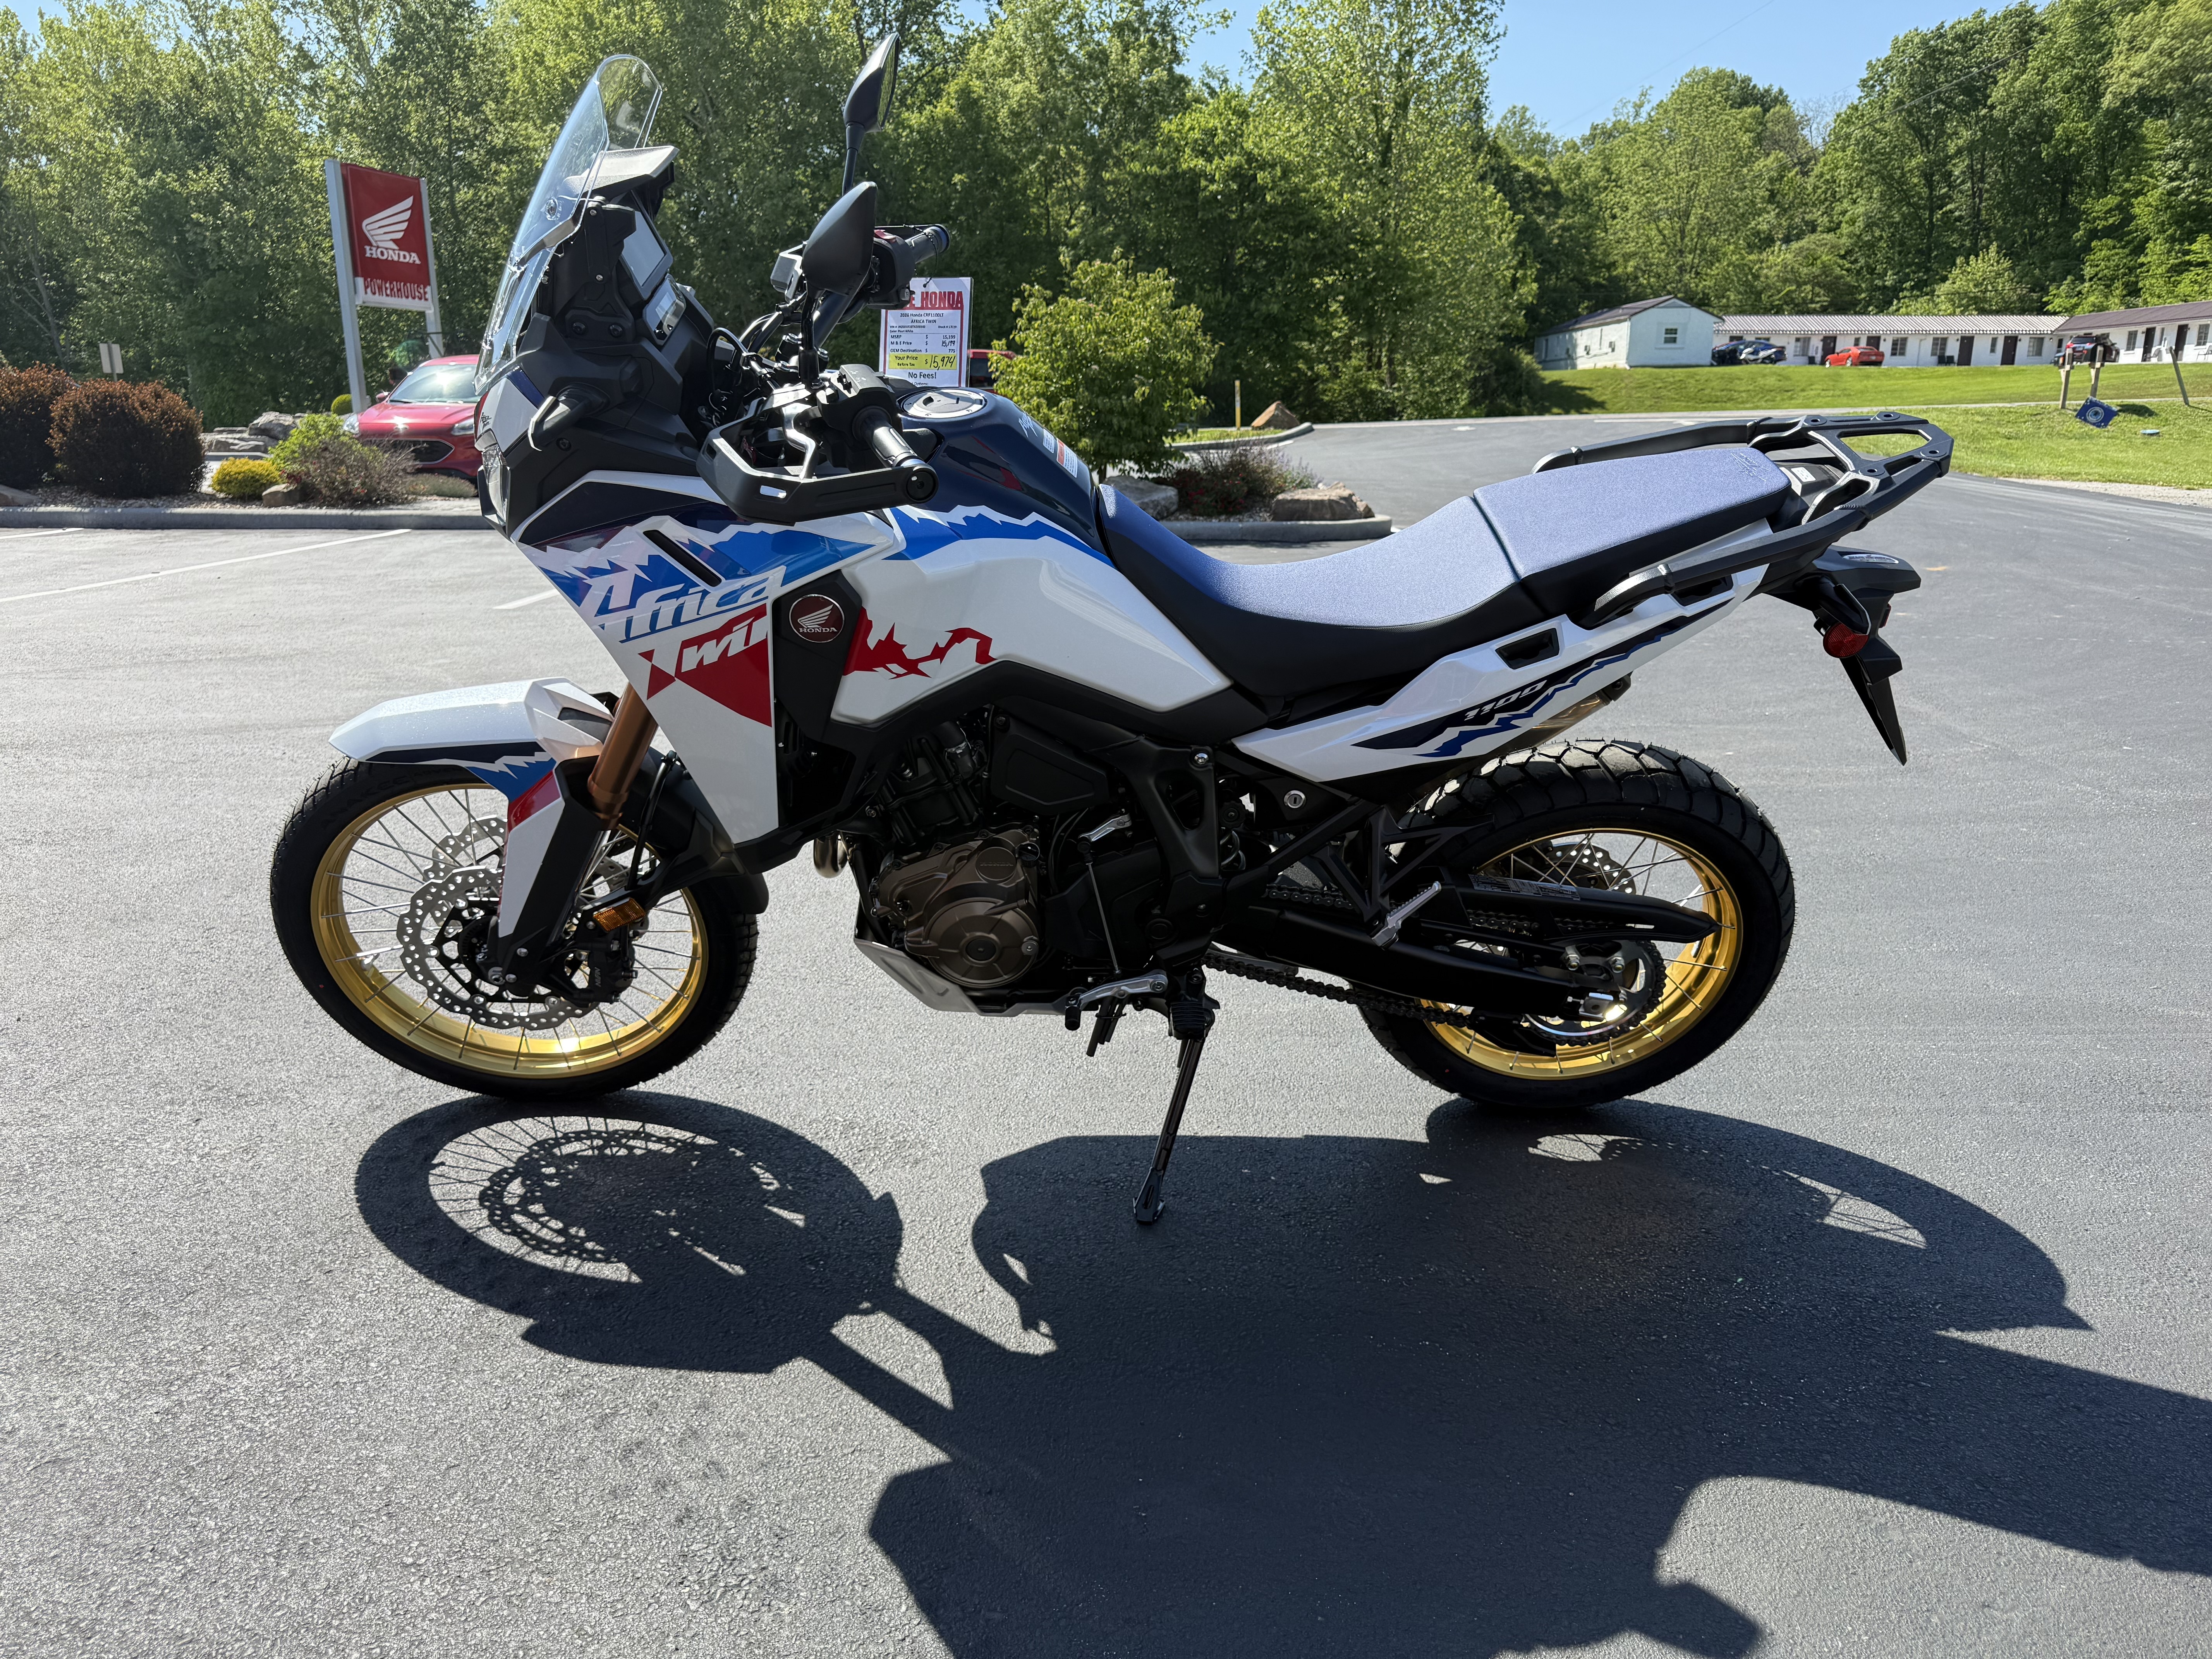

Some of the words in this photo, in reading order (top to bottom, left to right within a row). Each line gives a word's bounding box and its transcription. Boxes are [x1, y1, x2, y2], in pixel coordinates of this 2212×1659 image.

[364, 245, 421, 264] HONDA
[364, 278, 428, 301] POWERHOUSE
[921, 291, 963, 307] HONDA
[930, 354, 956, 371] 15,974
[1464, 680, 1547, 721] 1100
